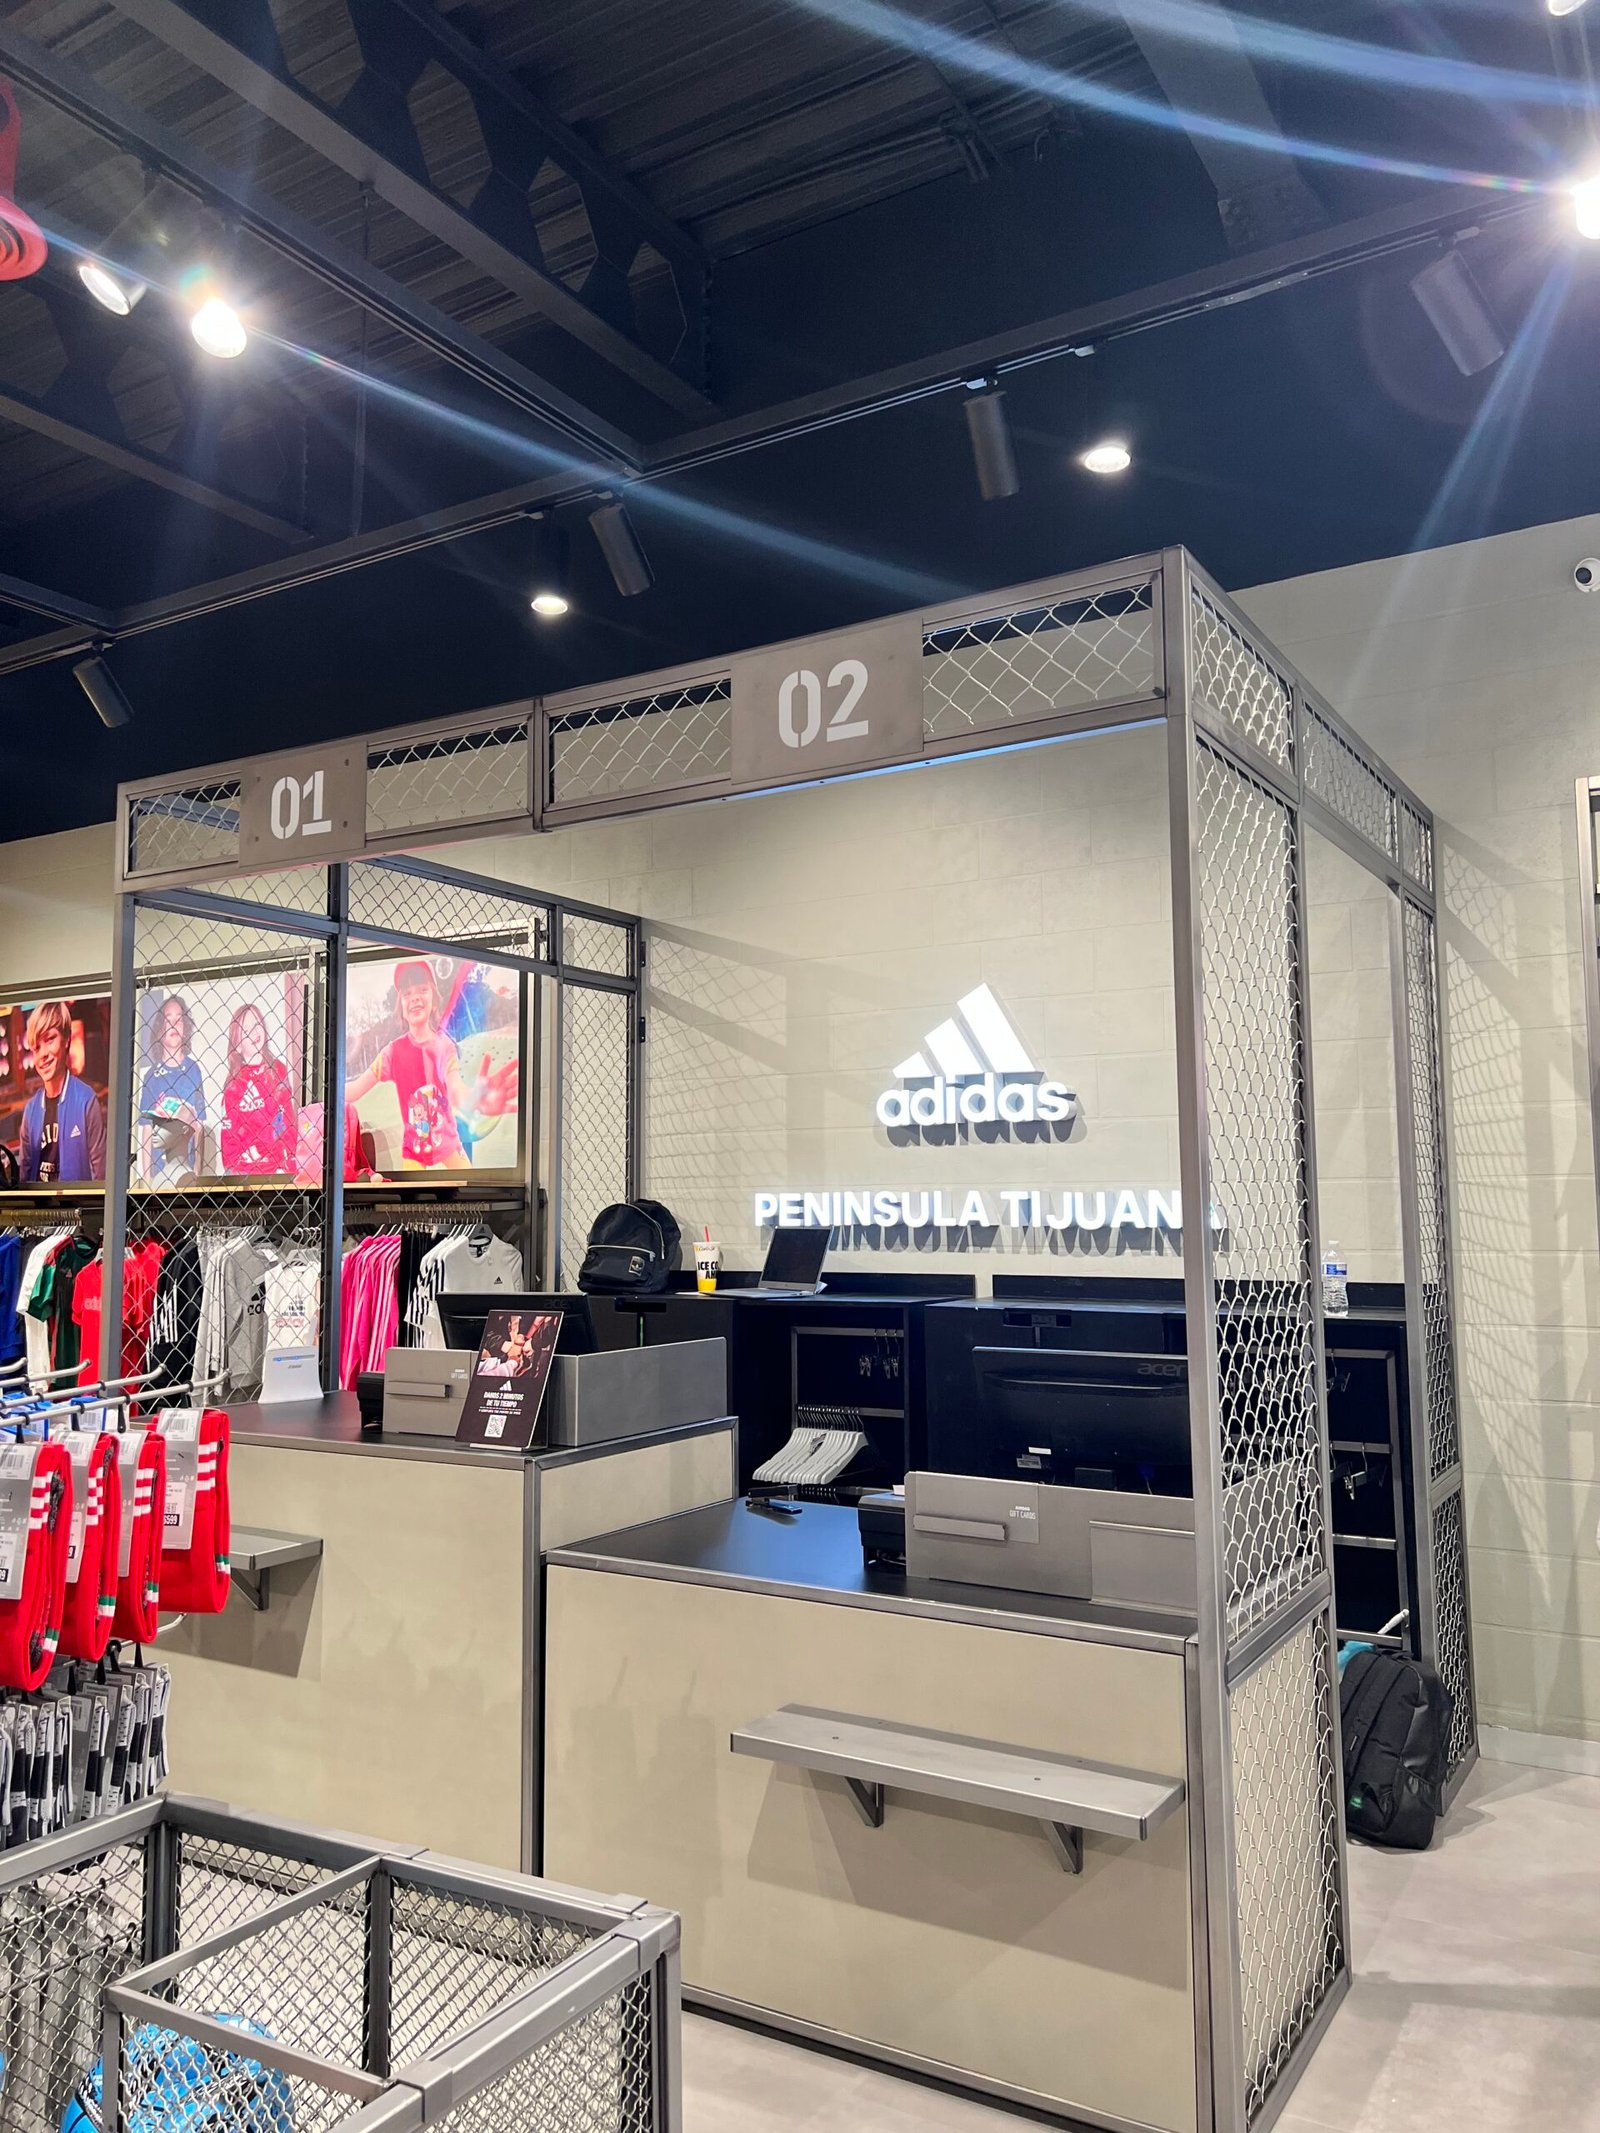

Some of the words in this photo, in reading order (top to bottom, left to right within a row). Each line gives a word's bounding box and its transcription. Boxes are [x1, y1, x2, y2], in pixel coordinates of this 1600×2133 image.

[778, 659, 869, 748] 02
[271, 770, 332, 839] 01
[876, 1072, 1071, 1128] adidas
[754, 1190, 990, 1228] PENINSULA
[698, 1261, 710, 1270] ICE
[1137, 1362, 1187, 1377] acer
